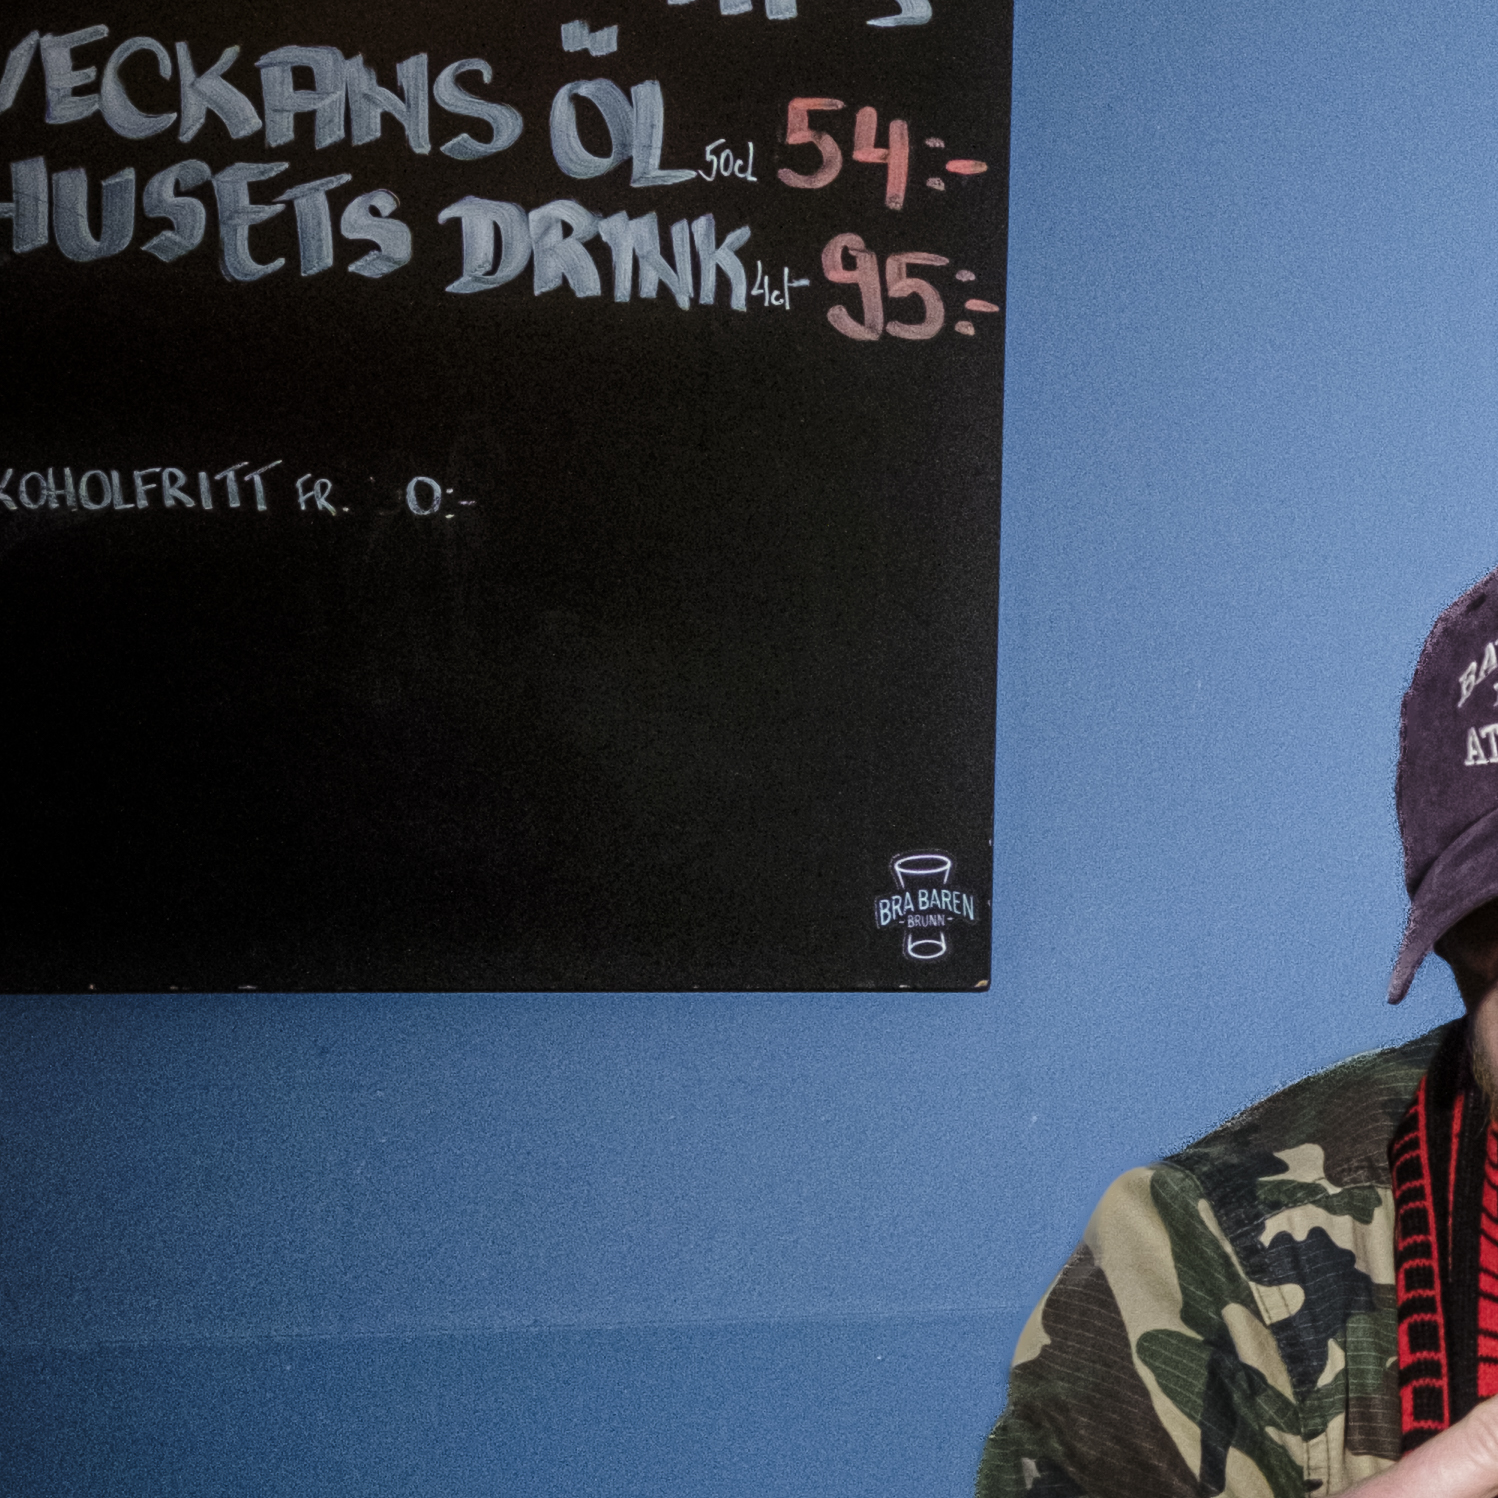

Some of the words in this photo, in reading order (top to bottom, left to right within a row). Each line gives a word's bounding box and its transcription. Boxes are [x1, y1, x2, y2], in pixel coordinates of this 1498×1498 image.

[549, 18, 698, 188] ÖL
[437, 195, 750, 313] DRINK
[879, 891, 915, 926] BRA
[917, 888, 975, 921] BAREN
[907, 913, 946, 928] BRUNN
